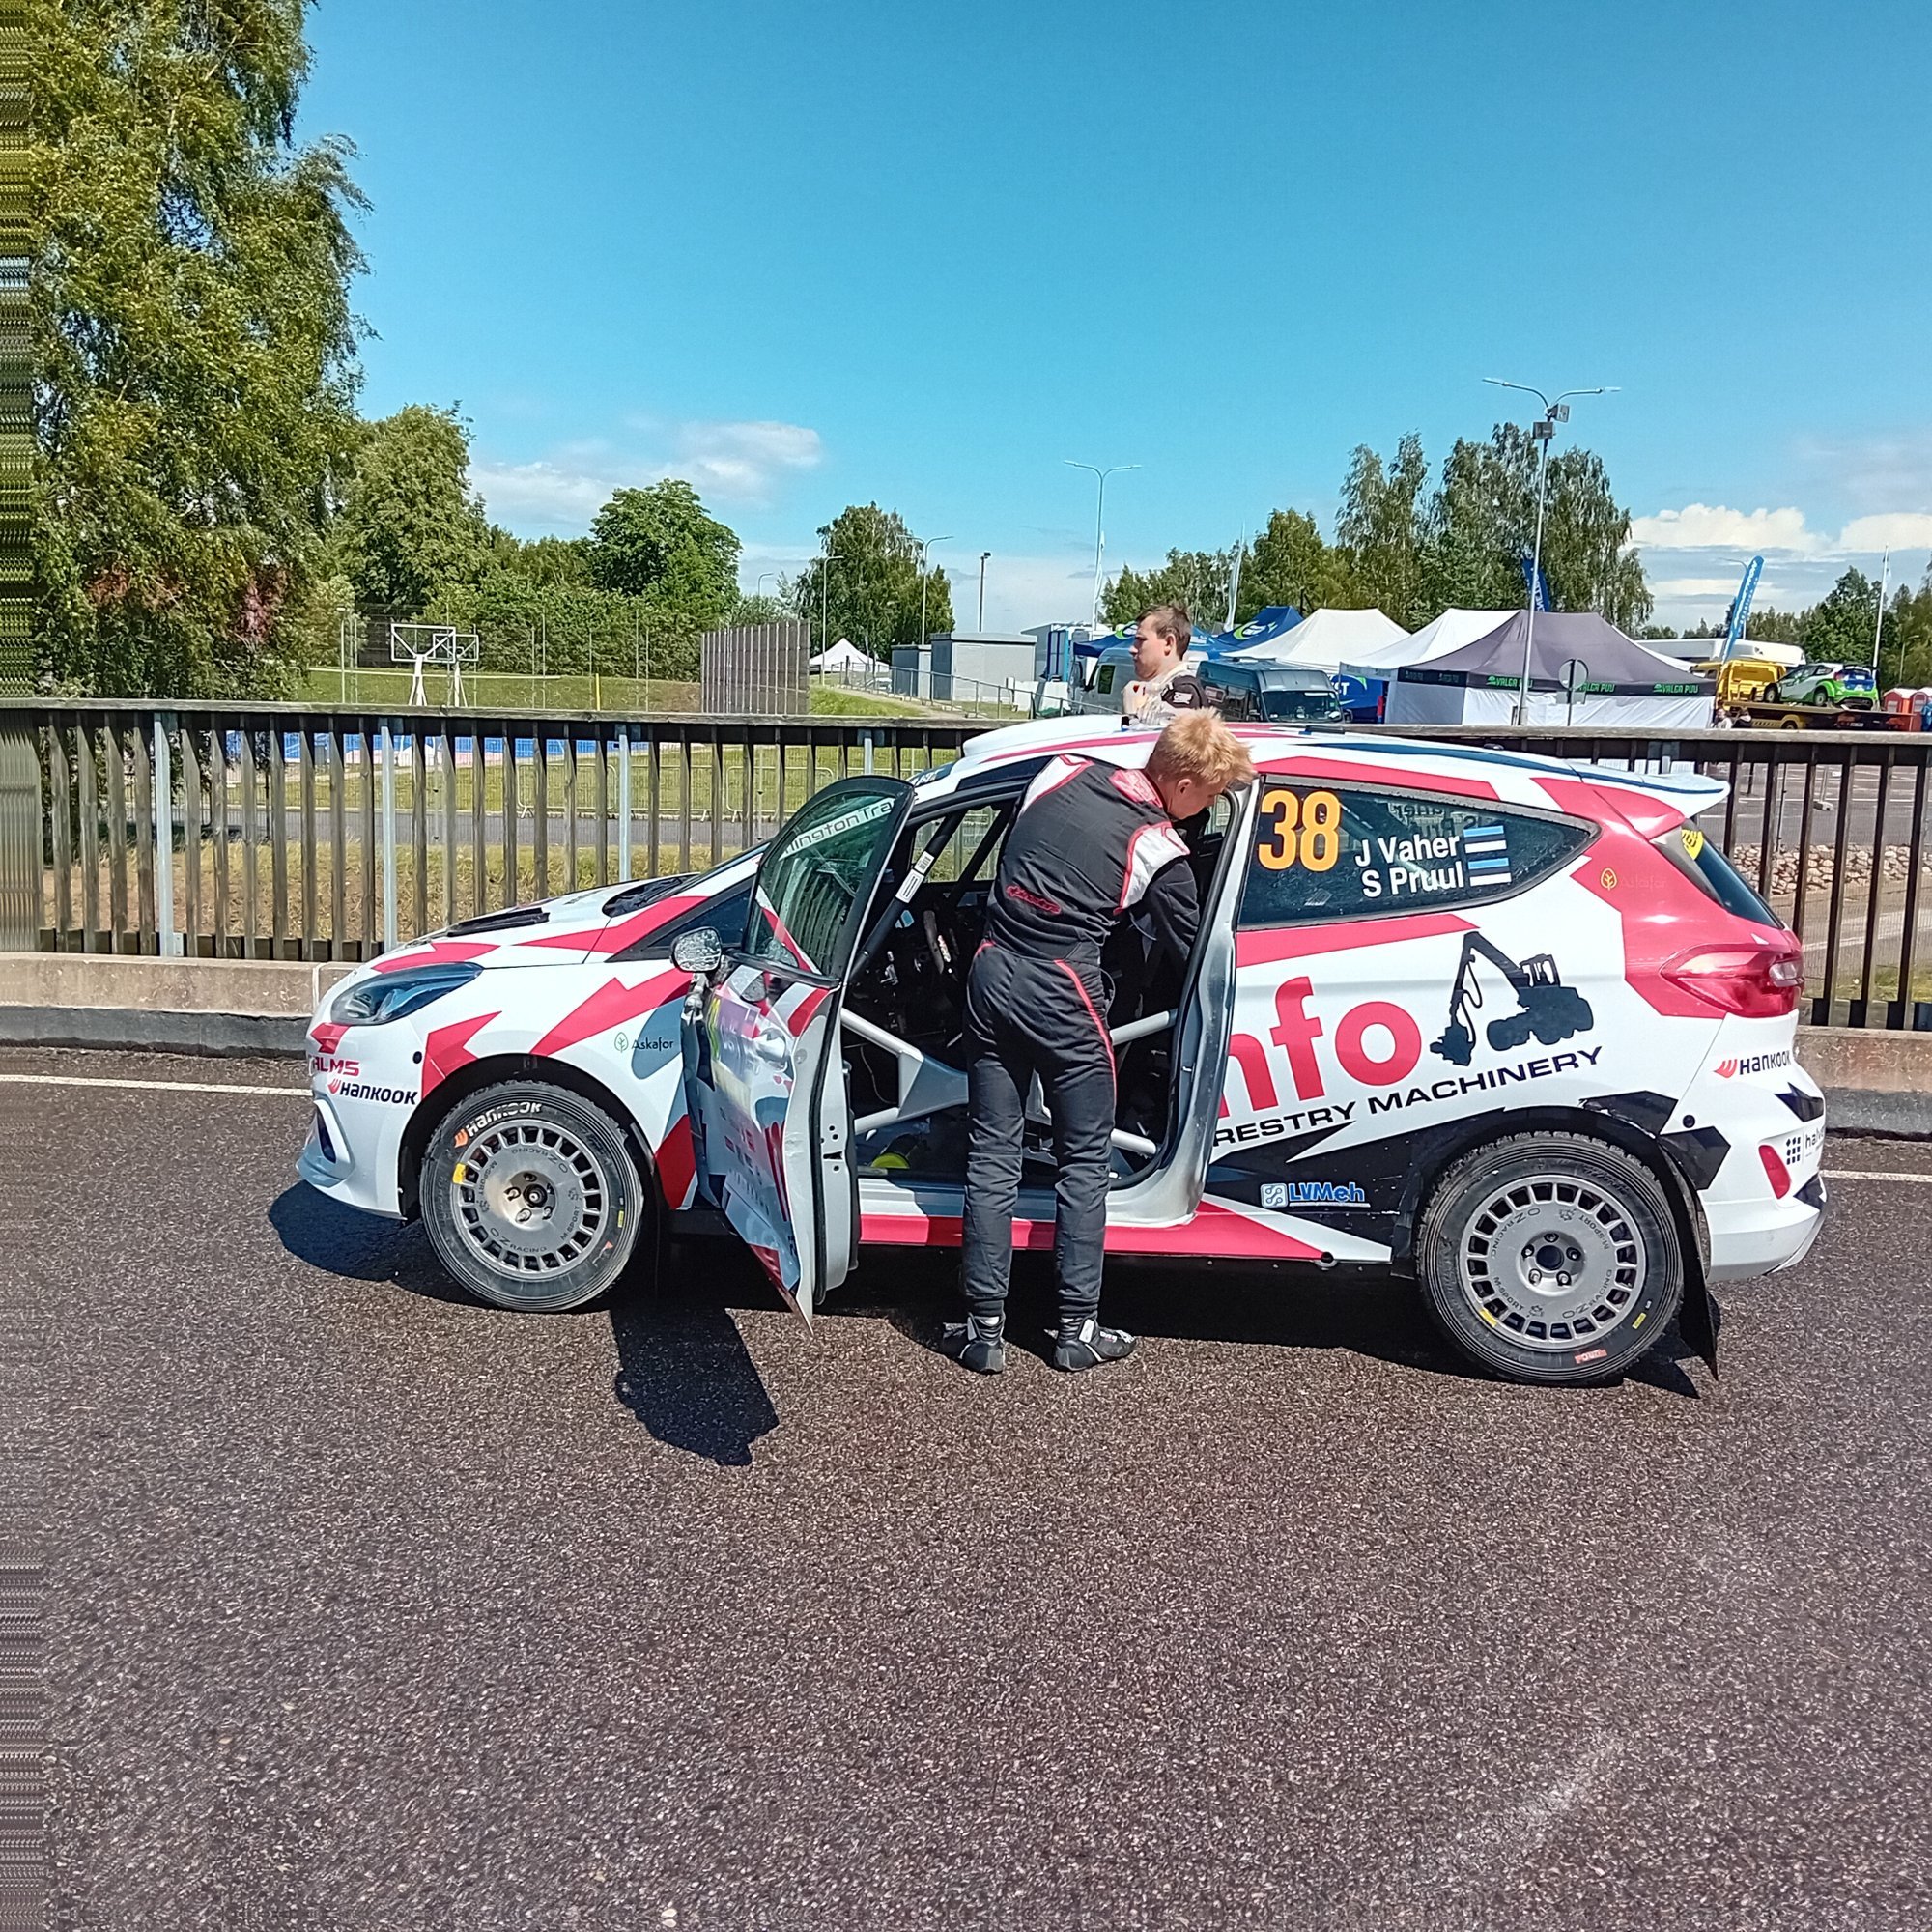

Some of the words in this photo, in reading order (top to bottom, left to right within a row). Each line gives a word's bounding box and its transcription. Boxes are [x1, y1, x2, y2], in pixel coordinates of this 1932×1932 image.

[1257, 789, 1342, 872] 38
[1354, 838, 1372, 867] J
[1377, 833, 1461, 864] Vaher
[1361, 869, 1382, 898] S
[1388, 861, 1464, 895] Pruul
[631, 1037, 674, 1052] Askafor
[309, 1054, 360, 1077] ALMS
[1213, 1101, 1356, 1147] RESTRY
[1368, 1046, 1604, 1115] MACHINERY
[1288, 1181, 1366, 1204] LVMeh
